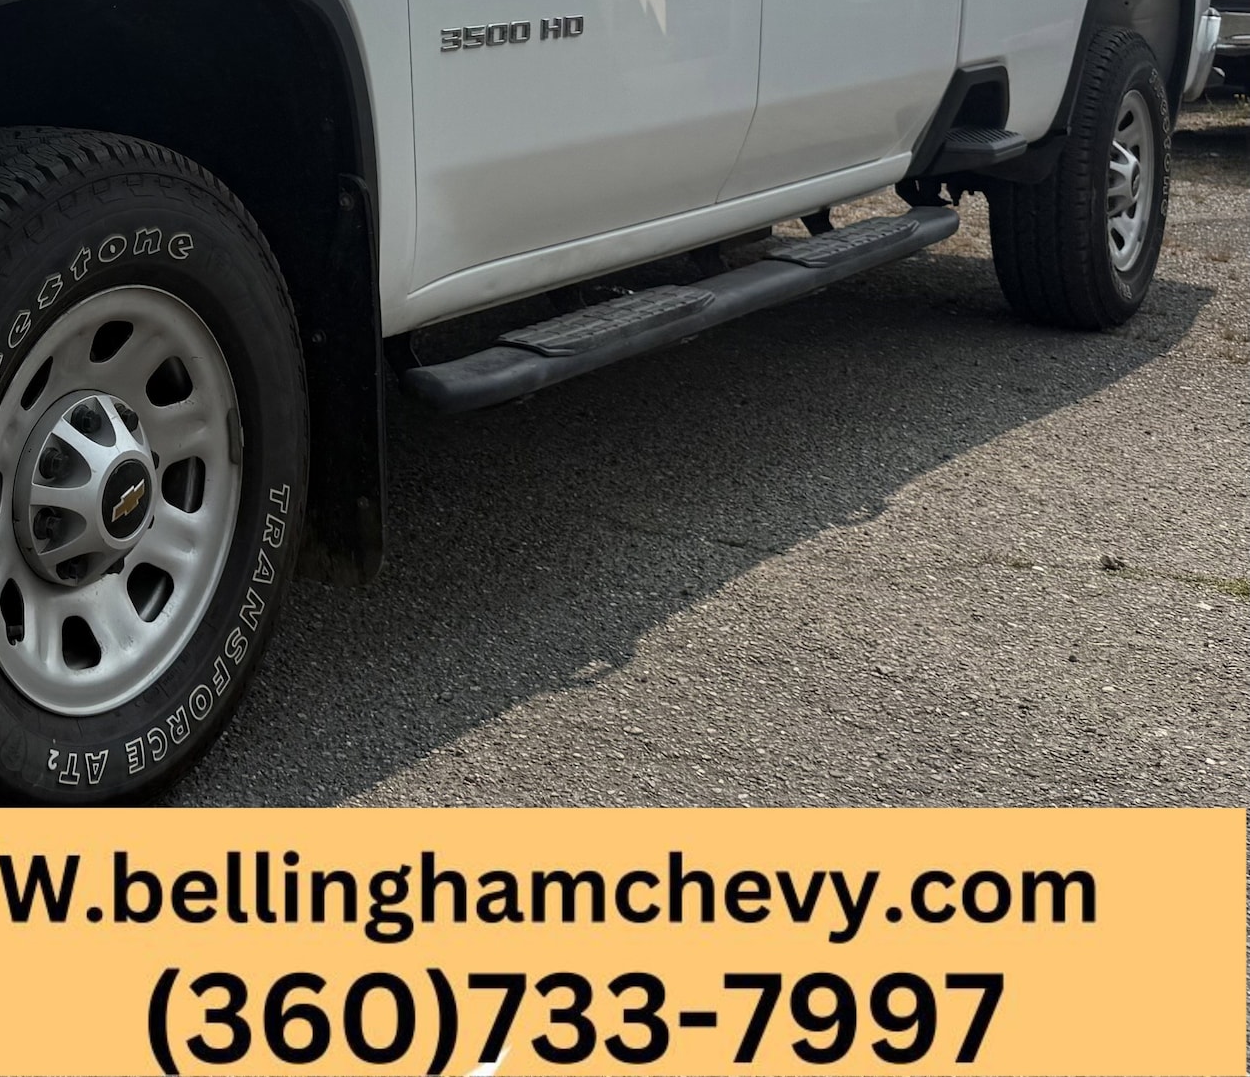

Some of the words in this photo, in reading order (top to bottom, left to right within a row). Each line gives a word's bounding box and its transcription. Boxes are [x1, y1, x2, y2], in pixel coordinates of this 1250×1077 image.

[440, 21, 530, 52] 3500
[540, 15, 584, 40] HD
[124, 484, 291, 774] TRANSFORCE
